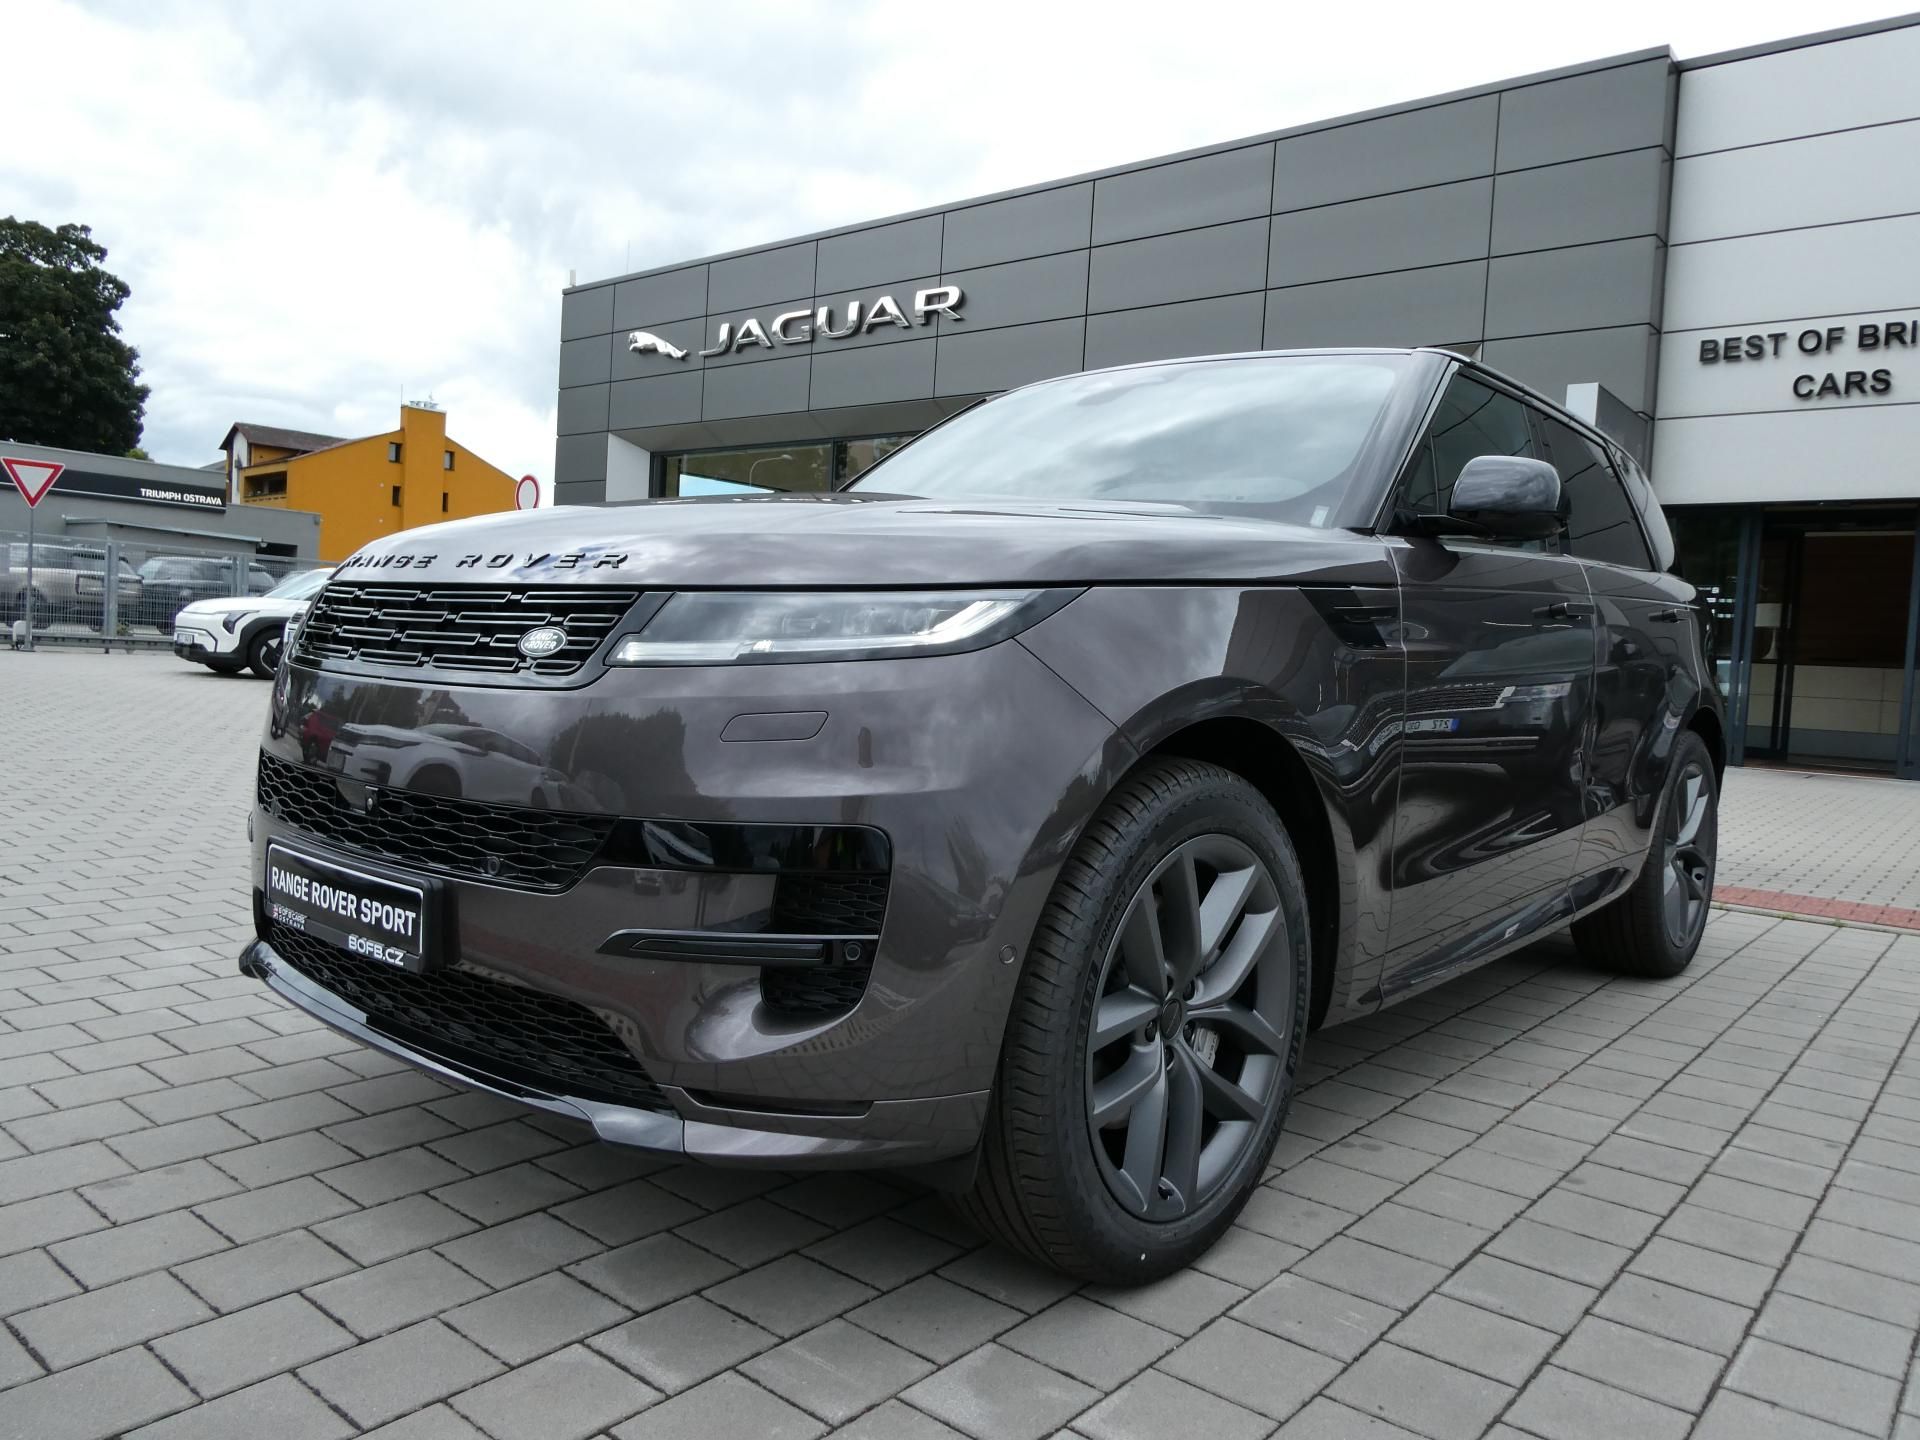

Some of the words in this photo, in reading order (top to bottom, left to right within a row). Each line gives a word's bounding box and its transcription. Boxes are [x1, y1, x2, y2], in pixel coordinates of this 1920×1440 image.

[699, 286, 965, 357] JAGUAR
[1700, 332, 1787, 362] BEST
[1798, 327, 1845, 353] OF
[1858, 320, 1919, 349] BRI
[1793, 369, 1892, 398] CARS
[140, 488, 181, 501] TRIUMPH
[184, 494, 222, 506] OSTRAVA
[456, 552, 629, 569] ROVER
[527, 640, 557, 650] ROVER
[529, 632, 554, 641] LAND
[272, 866, 309, 901] RANGE
[312, 881, 357, 919] ROVER
[361, 898, 416, 936] SPORT
[1097, 886, 1126, 951] PRIMACY
[349, 935, 405, 966] BOFB.CZ
